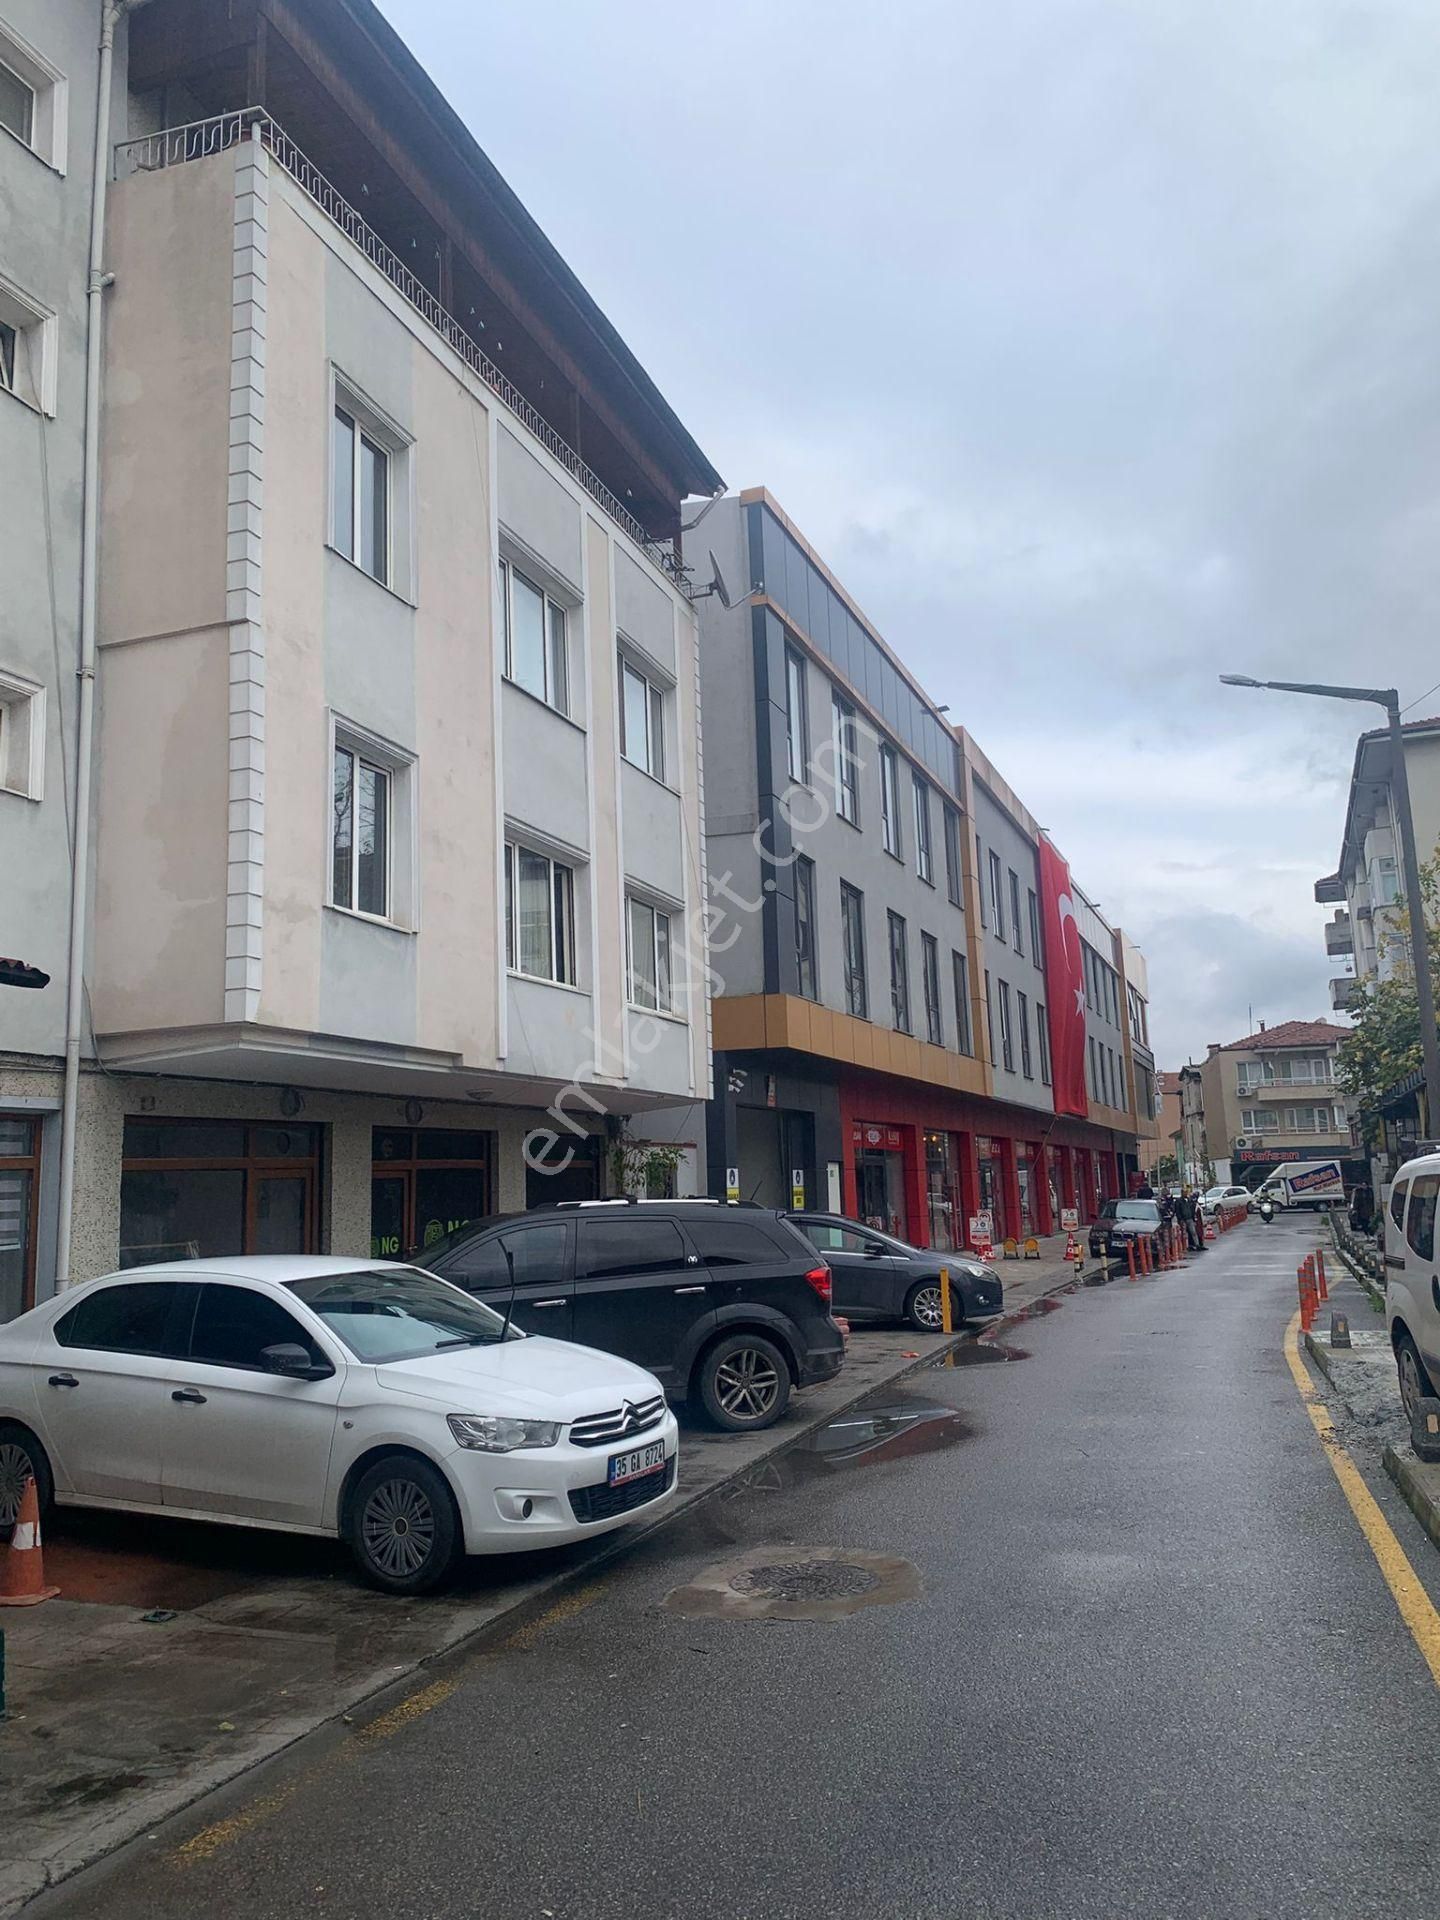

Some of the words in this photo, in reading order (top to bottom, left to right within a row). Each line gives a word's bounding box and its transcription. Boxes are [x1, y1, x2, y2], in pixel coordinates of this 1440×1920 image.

[616, 1457, 627, 1477] 35
[630, 1453, 641, 1472] GA
[645, 1443, 663, 1466] 8724
